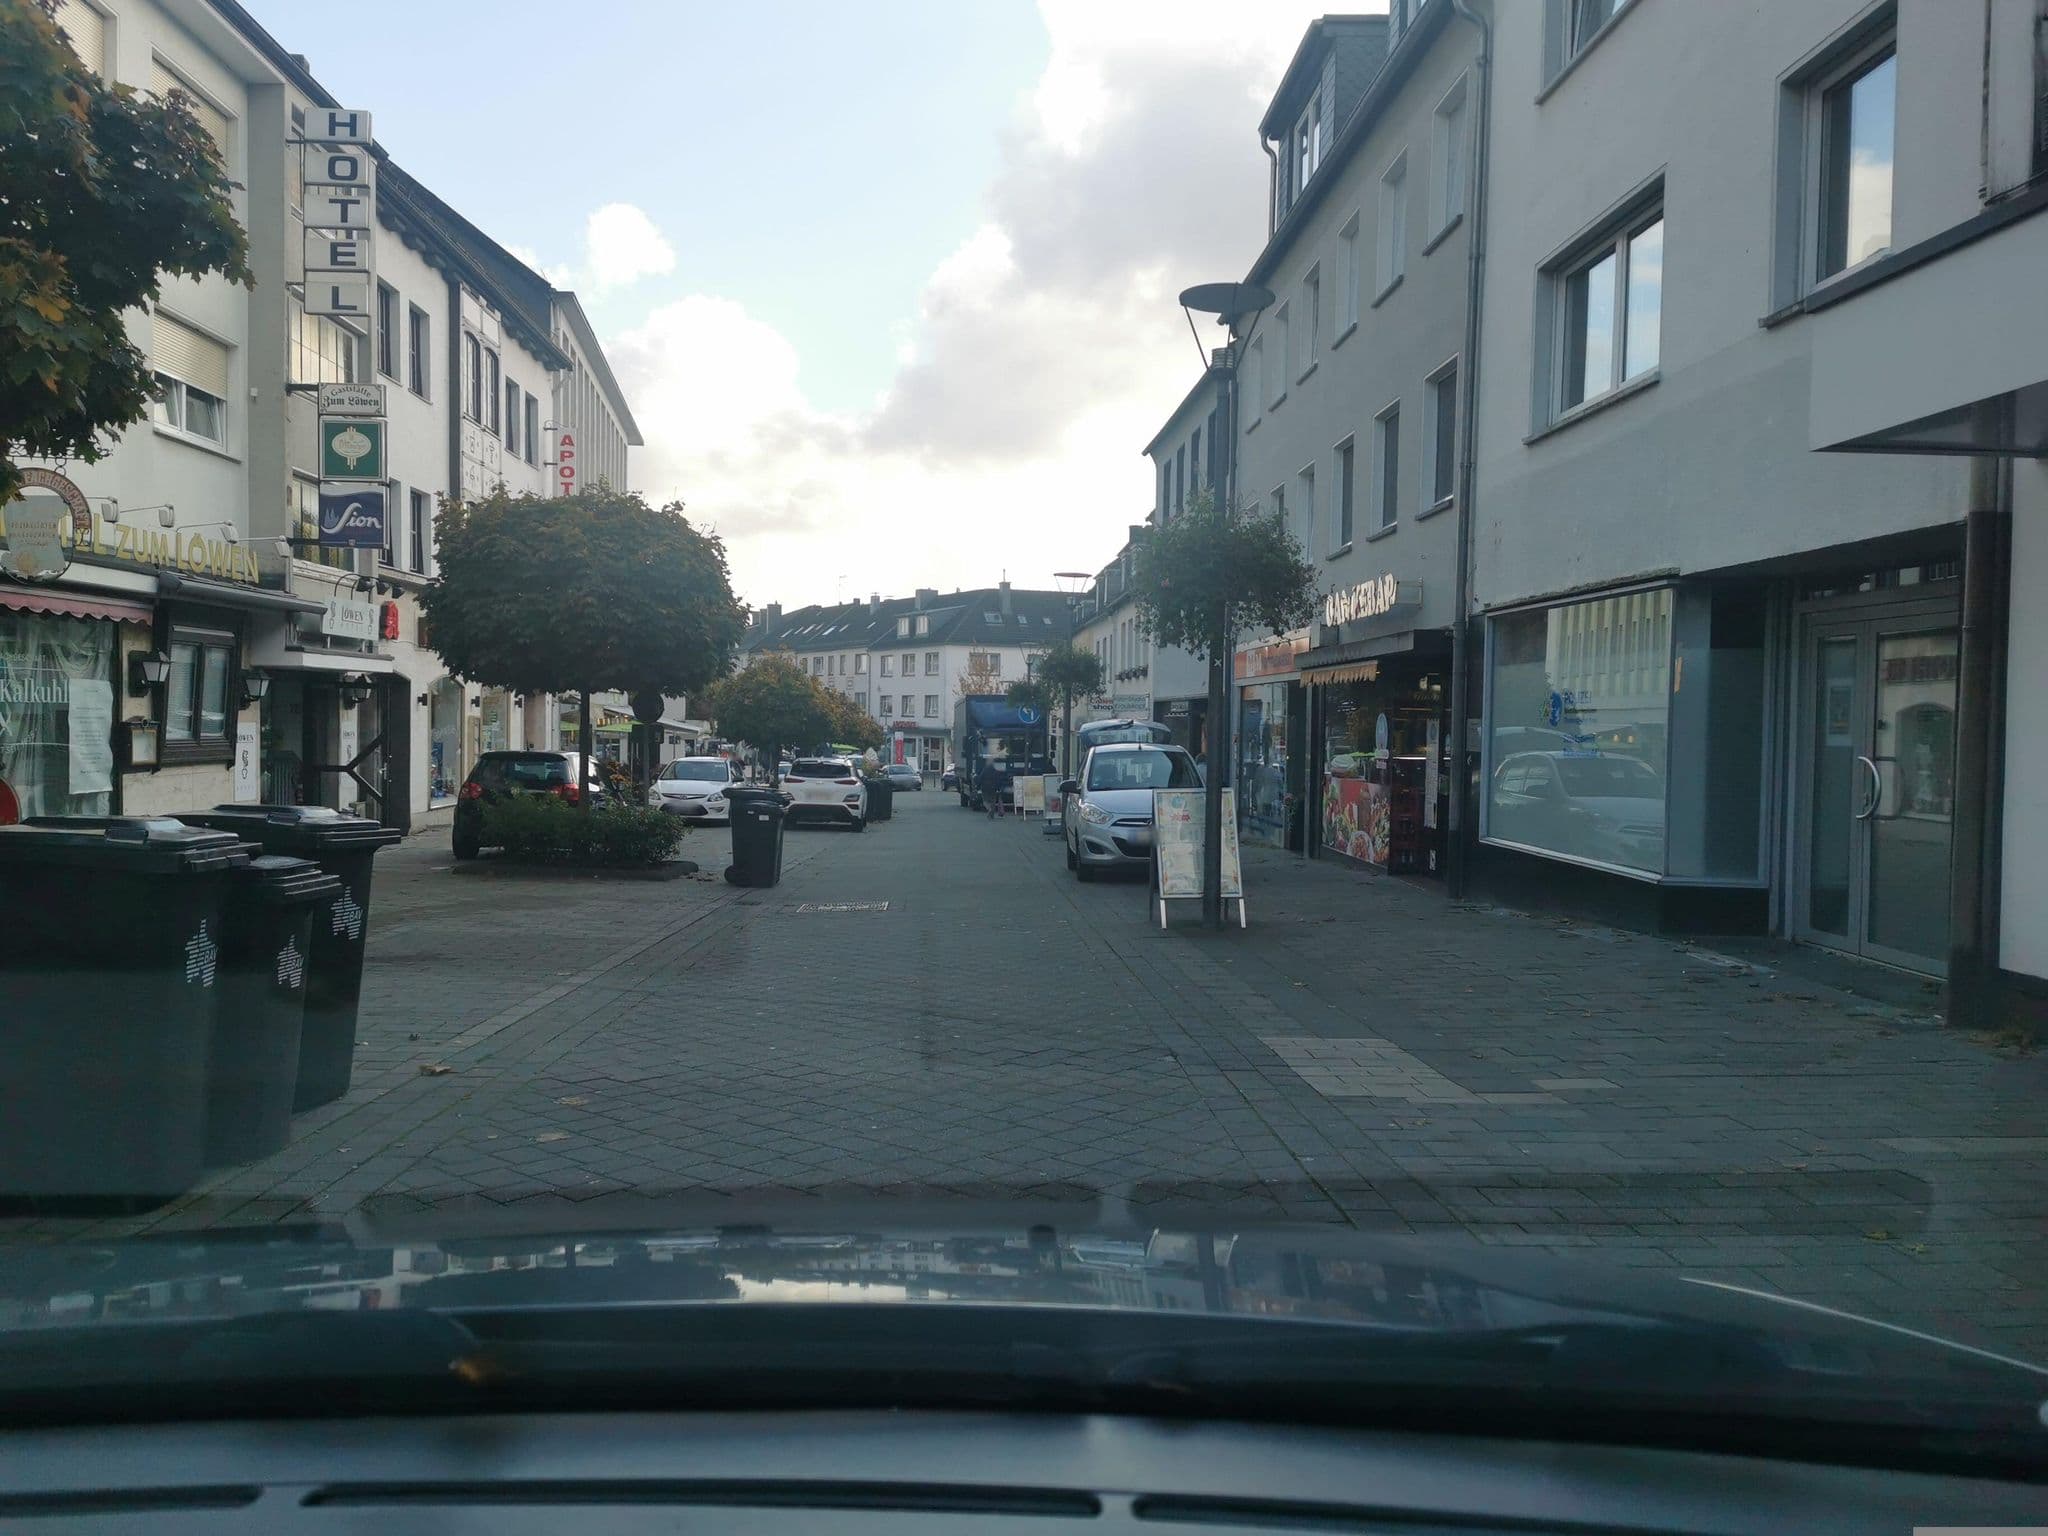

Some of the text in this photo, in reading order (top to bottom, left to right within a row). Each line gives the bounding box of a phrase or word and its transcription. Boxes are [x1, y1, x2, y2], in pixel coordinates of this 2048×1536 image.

[328, 112, 361, 311] HOTEL
[321, 395, 379, 408] Zum Löwen
[320, 502, 383, 534] Sion
[116, 523, 170, 567] ZUM
[176, 532, 260, 584] LÖWEN
[0, 678, 70, 703] Kalkuhl
[349, 910, 363, 921] BAV
[204, 947, 218, 962] BAV
